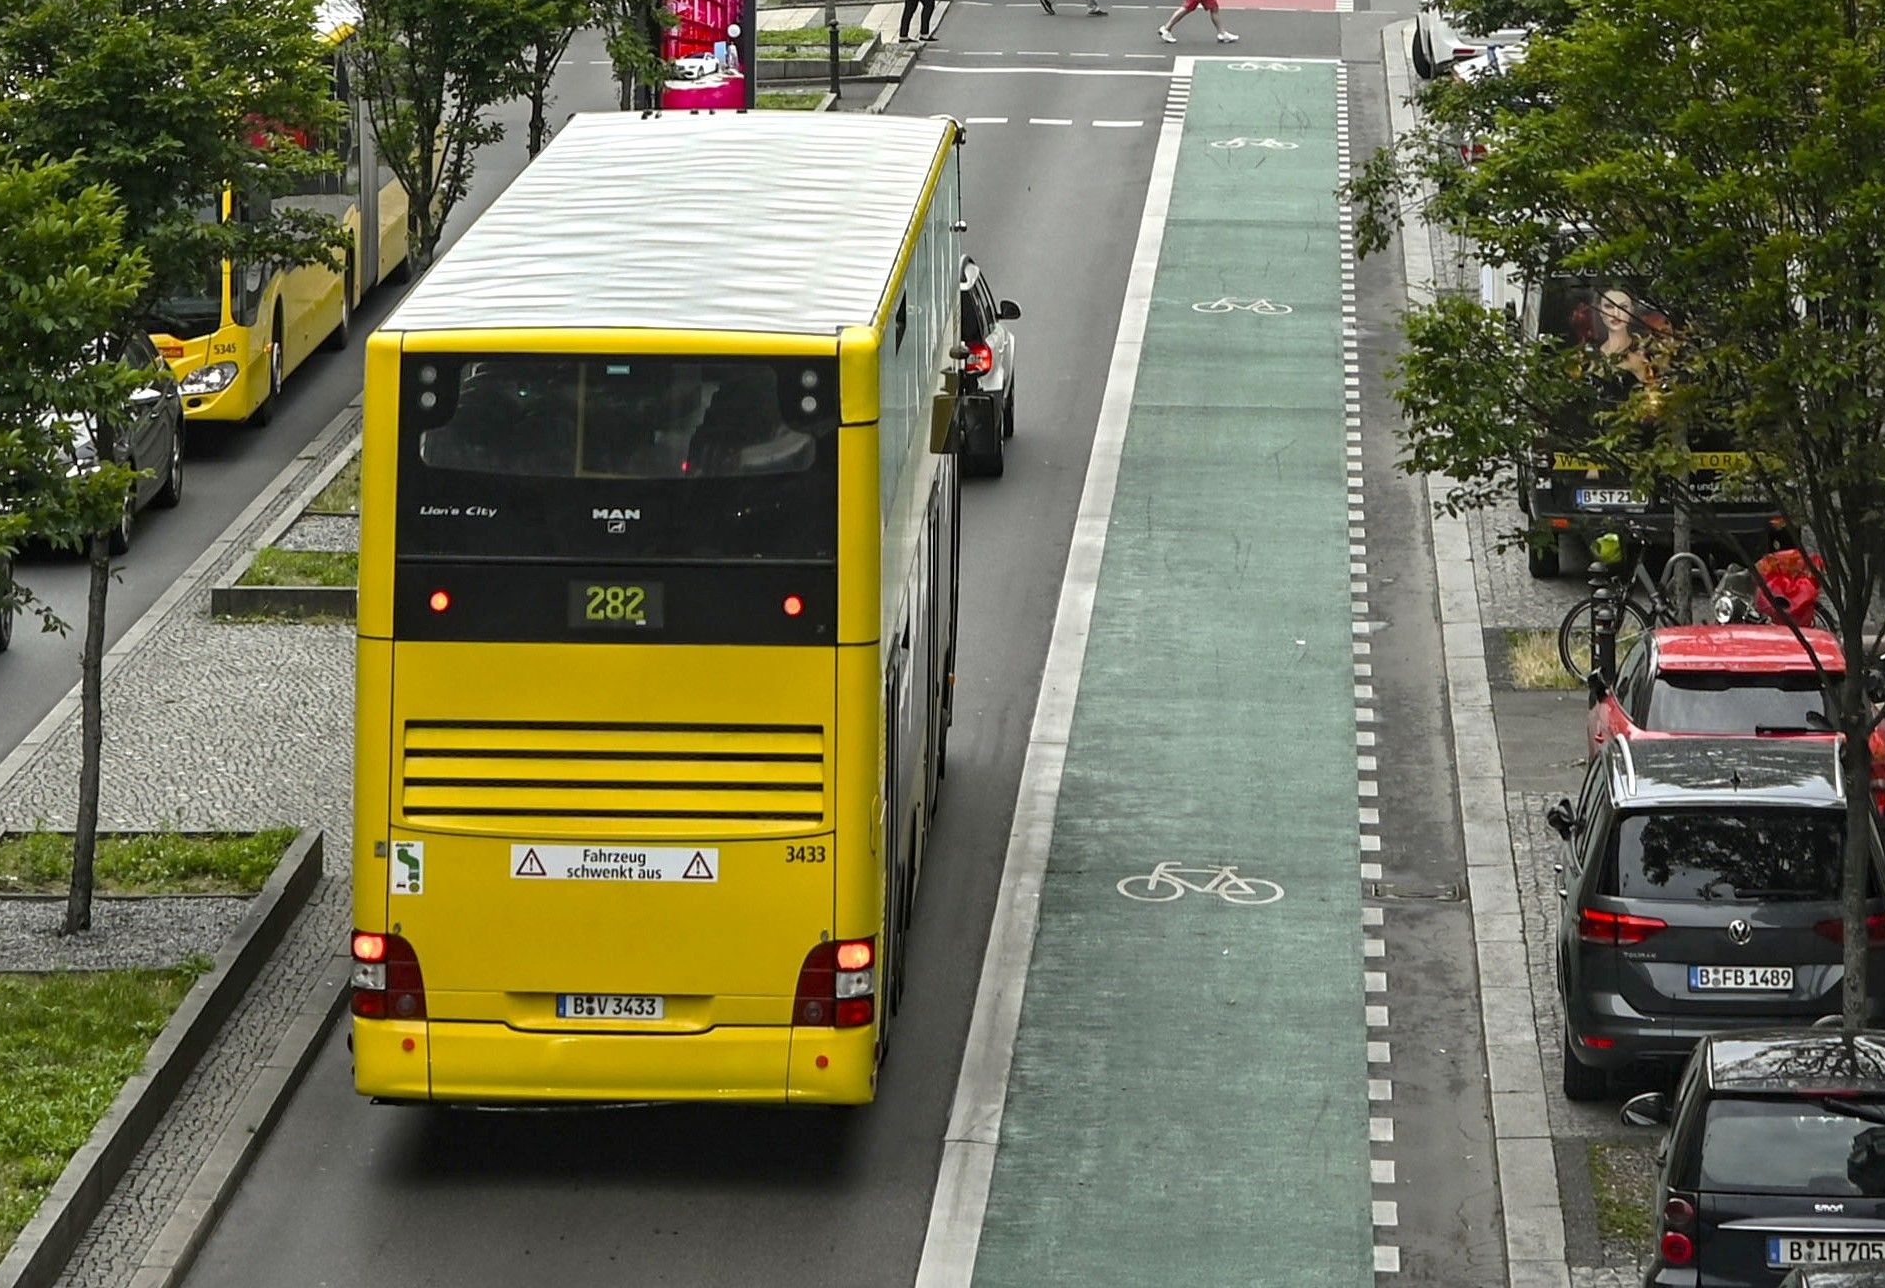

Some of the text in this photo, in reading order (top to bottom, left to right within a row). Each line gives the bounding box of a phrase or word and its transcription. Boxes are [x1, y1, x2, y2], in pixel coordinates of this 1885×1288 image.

[214, 342, 237, 355] 5345
[420, 505, 498, 518] Lion's City
[592, 508, 641, 520] MAN
[585, 586, 645, 621] 282
[582, 848, 647, 867] Fahrzeug
[785, 846, 826, 863] 3433
[567, 866, 662, 880] schwenkt aus
[1699, 969, 1791, 986] B FB 1489
[573, 997, 656, 1016] B V 3433
[1790, 1241, 1883, 1262] B IH 705
